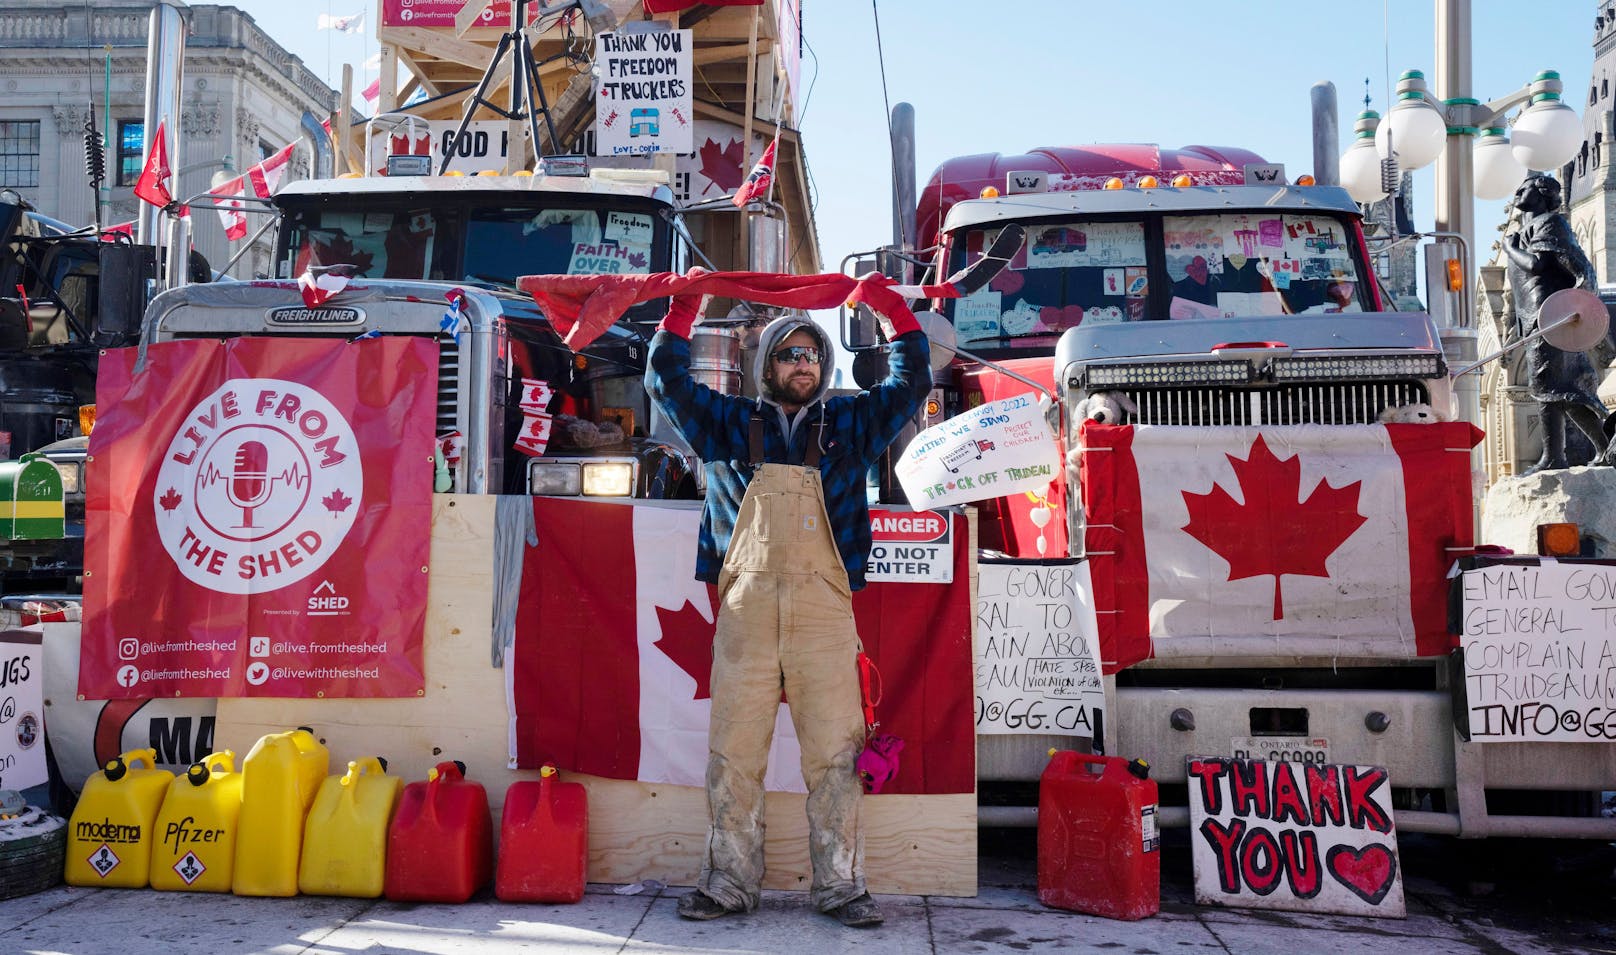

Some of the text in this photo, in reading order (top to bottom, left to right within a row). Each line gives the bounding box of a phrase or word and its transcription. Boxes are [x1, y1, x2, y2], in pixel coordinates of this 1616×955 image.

[600, 32, 682, 53] THANK YOU
[608, 57, 677, 77] FREEDOM
[604, 79, 686, 100] TRUCKERS
[441, 130, 489, 158] GOD
[610, 214, 650, 229] Freedom
[575, 243, 628, 259] FAITH
[574, 257, 620, 273] OVER
[274, 309, 355, 321] FREIGHTLINER
[1002, 396, 1030, 412] 2022
[172, 390, 347, 469] LIVE FROM
[911, 414, 1010, 460] UNITED WE STAND
[1004, 420, 1033, 434] PROTECT
[978, 471, 999, 484] OFF
[1004, 463, 1051, 481] TRUDEAU
[871, 517, 939, 533] ANGER
[179, 526, 322, 580] THE SHED
[895, 547, 939, 560] NOT
[866, 561, 930, 575] ENTER
[308, 597, 349, 609] SHED
[1036, 603, 1072, 630] TO
[1465, 606, 1583, 636] GENERAL
[272, 641, 387, 654] @live.fromtheshed
[271, 667, 380, 679] @livewiththeshed
[1033, 659, 1065, 675] HATE
[1467, 673, 1603, 701] TRUDEAU
[1260, 741, 1300, 749] ONTARIO
[1189, 757, 1394, 835] THANK
[76, 817, 141, 843] moderna
[164, 816, 226, 855] Pfizer
[1199, 817, 1323, 900] YOU
